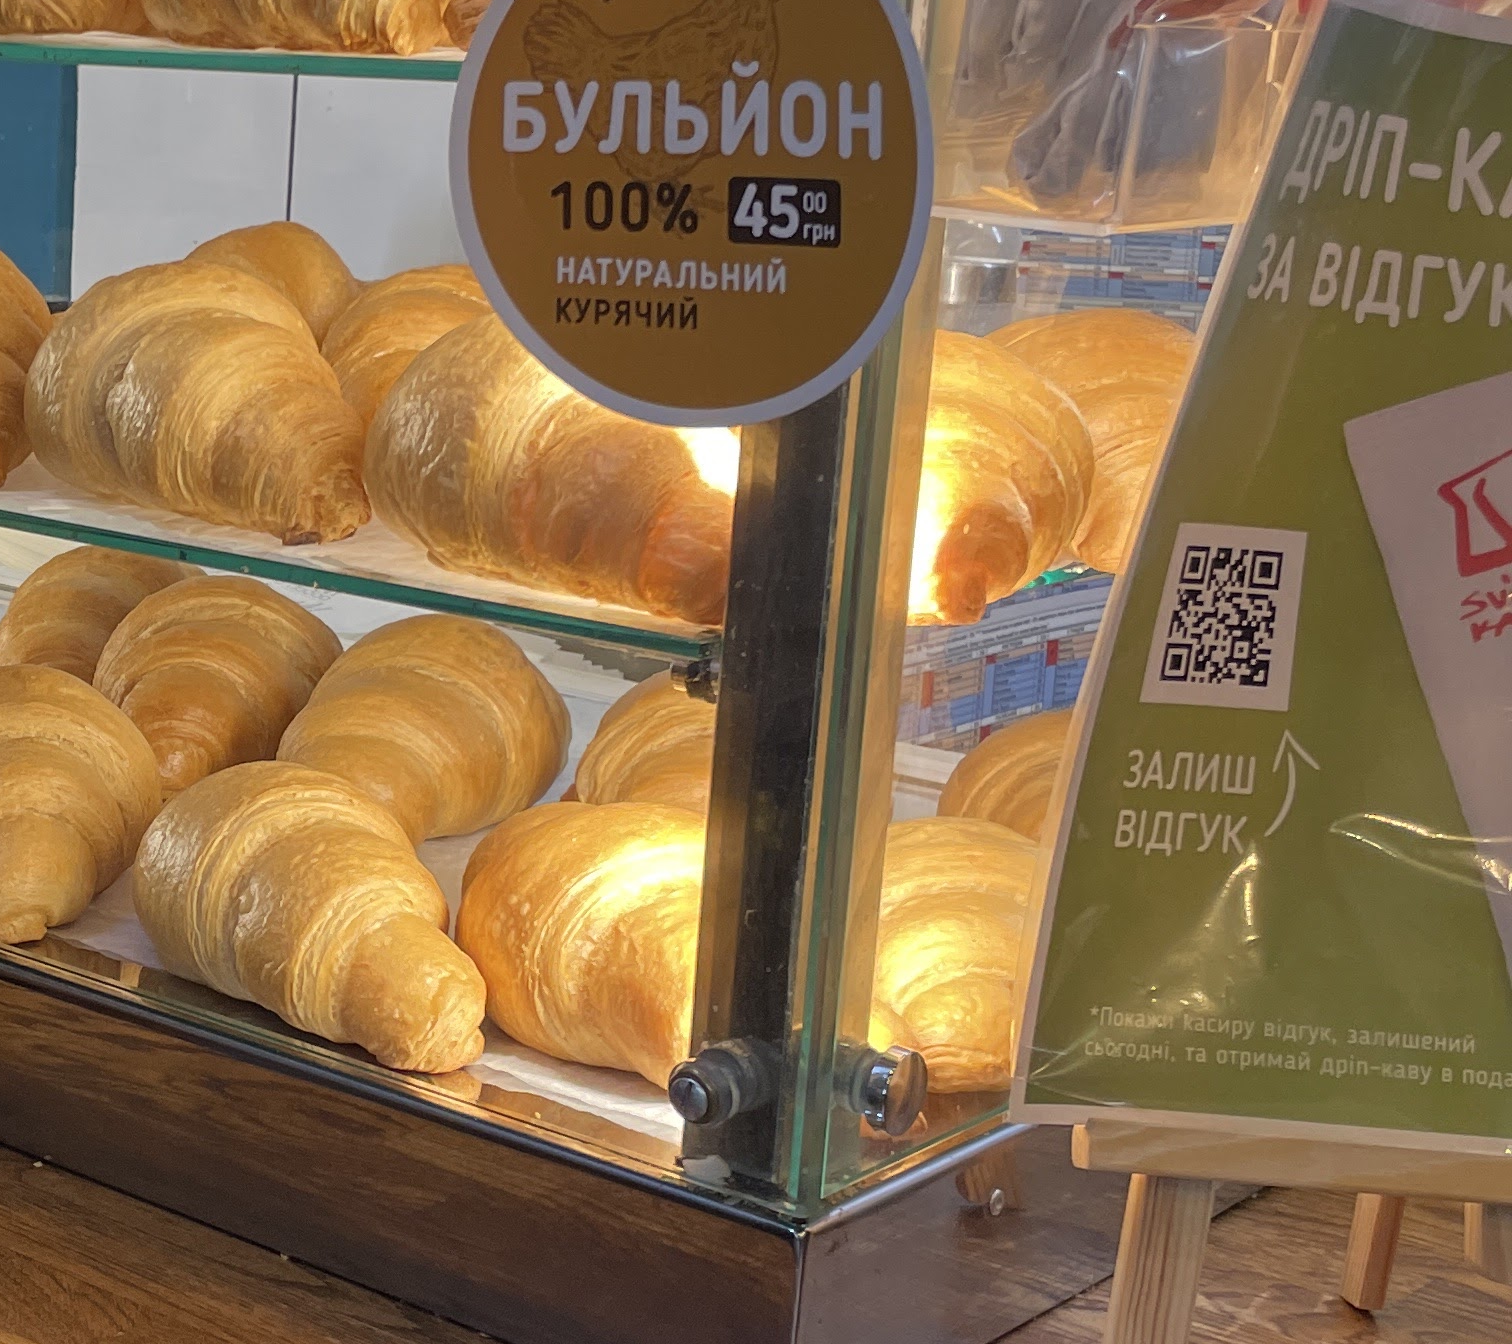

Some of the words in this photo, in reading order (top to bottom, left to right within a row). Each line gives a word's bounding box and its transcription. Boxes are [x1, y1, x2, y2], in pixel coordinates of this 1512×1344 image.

[502, 59, 883, 161] БУЛЬЙОН
[551, 181, 698, 234] 100%
[733, 182, 800, 239] 45
[803, 191, 827, 214] 00
[803, 223, 836, 246] грн
[556, 256, 787, 295] НАТУРАЛЬНИЙ
[1246, 232, 1296, 303] ЗА
[555, 296, 698, 330] КУРЯЧИЙ
[1123, 749, 1256, 795] ЗАЛИШ
[1114, 809, 1248, 856] ВІДГУК
[1183, 1014, 1255, 1041] касиру
[1263, 1018, 1337, 1045] відгук,
[1347, 1028, 1476, 1055] залишений
[1084, 1040, 1176, 1063] сьогодні,
[1185, 1047, 1207, 1063] та
[1216, 1051, 1311, 1071] отримай
[1320, 1055, 1432, 1086] дріп-каву
[1441, 1067, 1454, 1083] в
